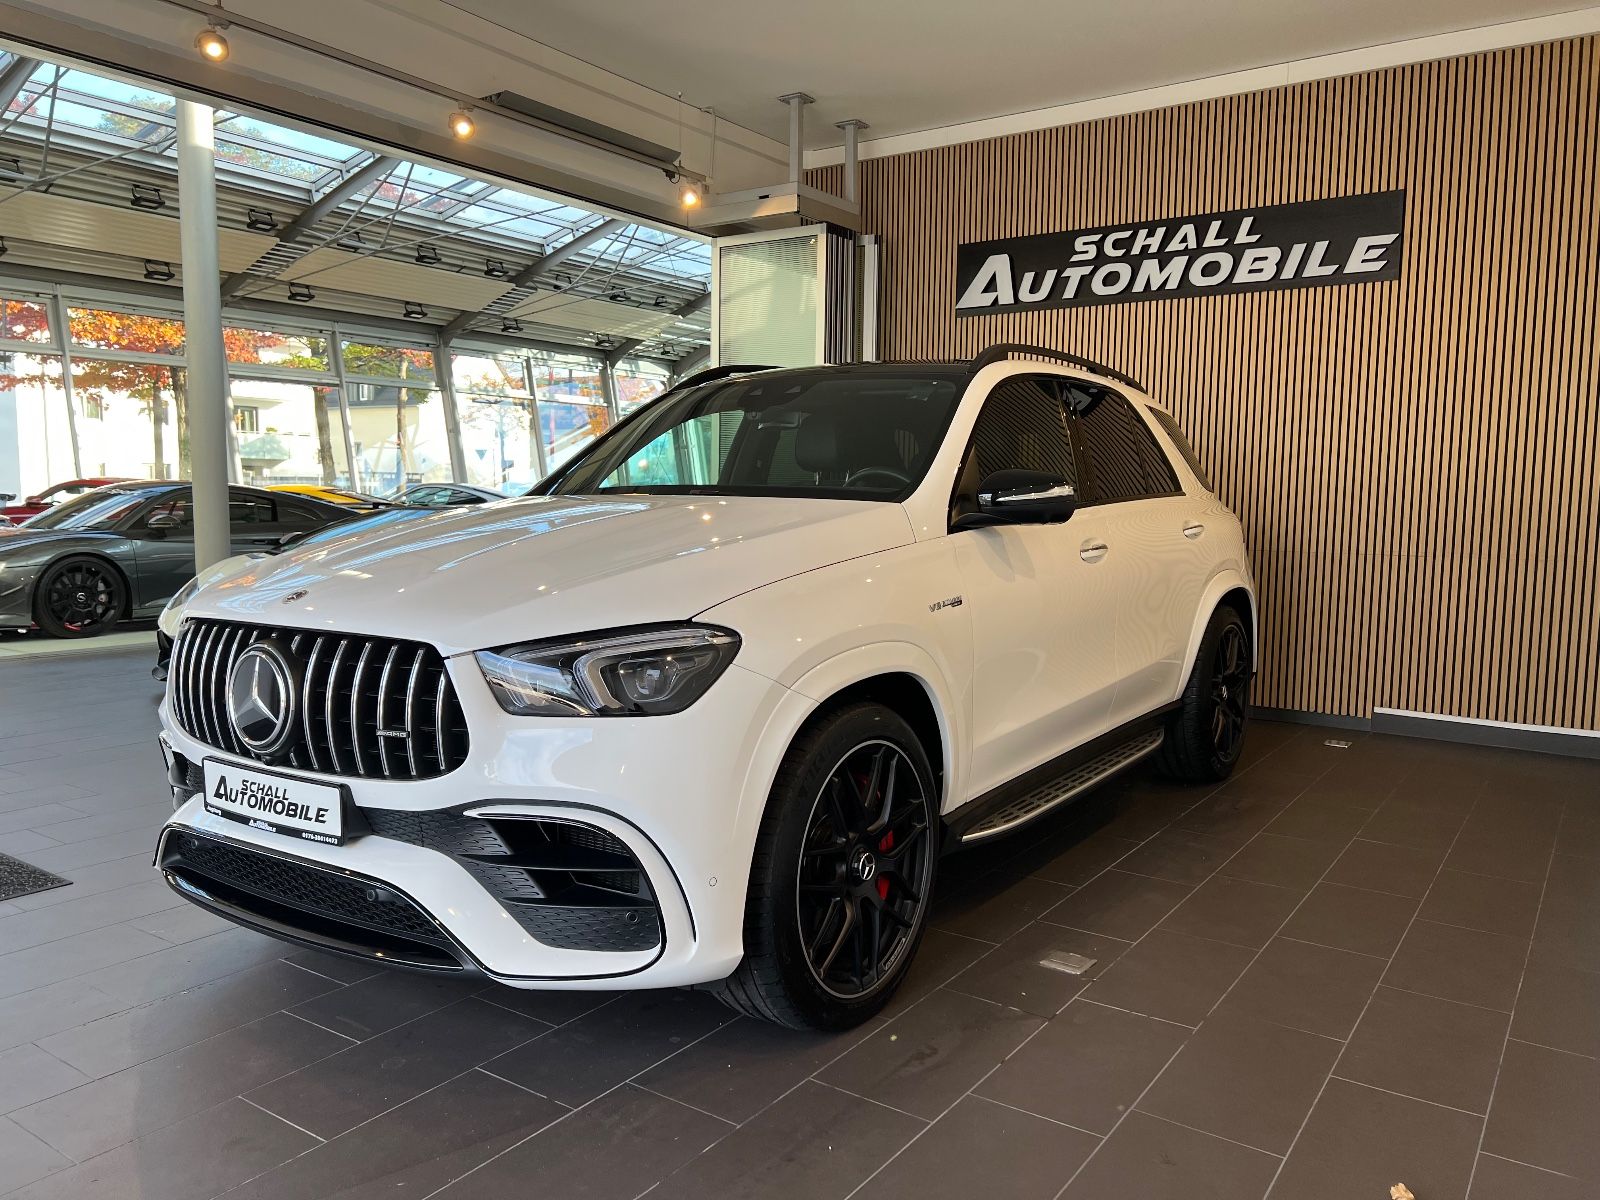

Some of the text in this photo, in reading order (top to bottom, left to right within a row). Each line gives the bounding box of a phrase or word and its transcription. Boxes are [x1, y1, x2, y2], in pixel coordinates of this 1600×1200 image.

[1069, 216, 1263, 262] SCHALL
[955, 232, 1400, 309] AUTOMOBILE
[384, 730, 407, 738] AMG
[213, 775, 329, 824] AUTOMOBILE
[240, 779, 290, 801] SCHALL
